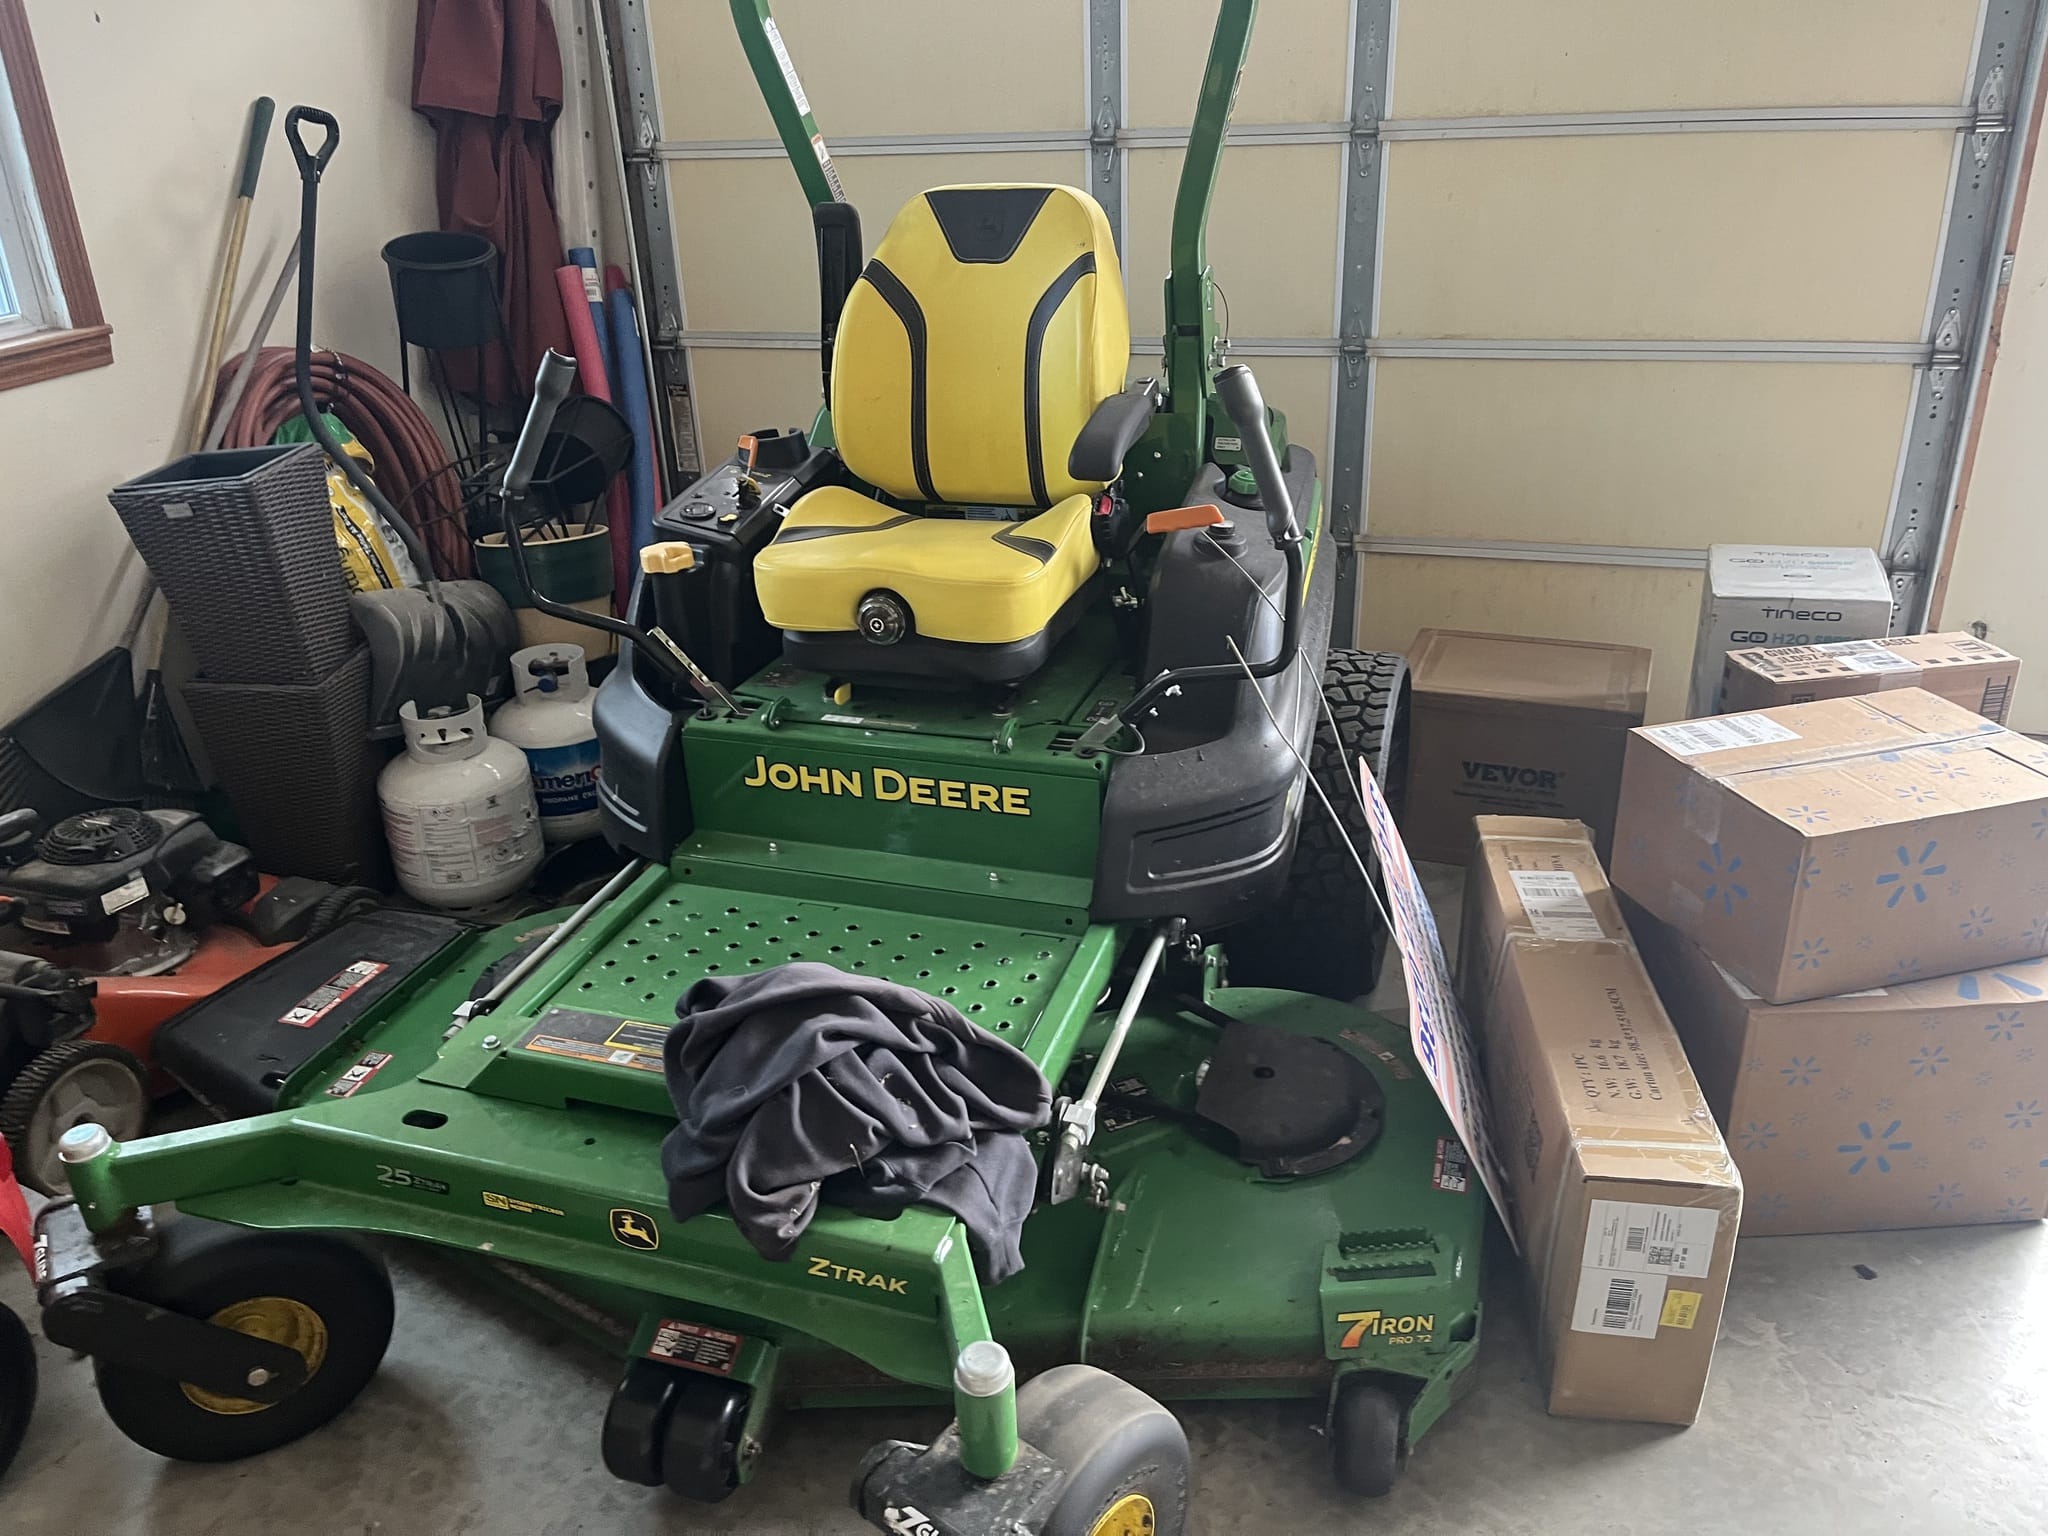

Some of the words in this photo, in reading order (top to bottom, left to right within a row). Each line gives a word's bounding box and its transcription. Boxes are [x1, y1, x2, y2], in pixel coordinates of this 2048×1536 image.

[1730, 630, 1768, 643] GO
[744, 755, 863, 798] JOHN
[872, 767, 1031, 816] DEERE
[1462, 760, 1558, 789] VEVOR
[1643, 1071, 1663, 1101] Carton
[807, 1256, 909, 1296] ZTRAK
[1337, 1310, 1381, 1349] 7
[1372, 1314, 1434, 1336] IRON
[1388, 1335, 1413, 1345] PRO
[1416, 1334, 1433, 1344] 72
